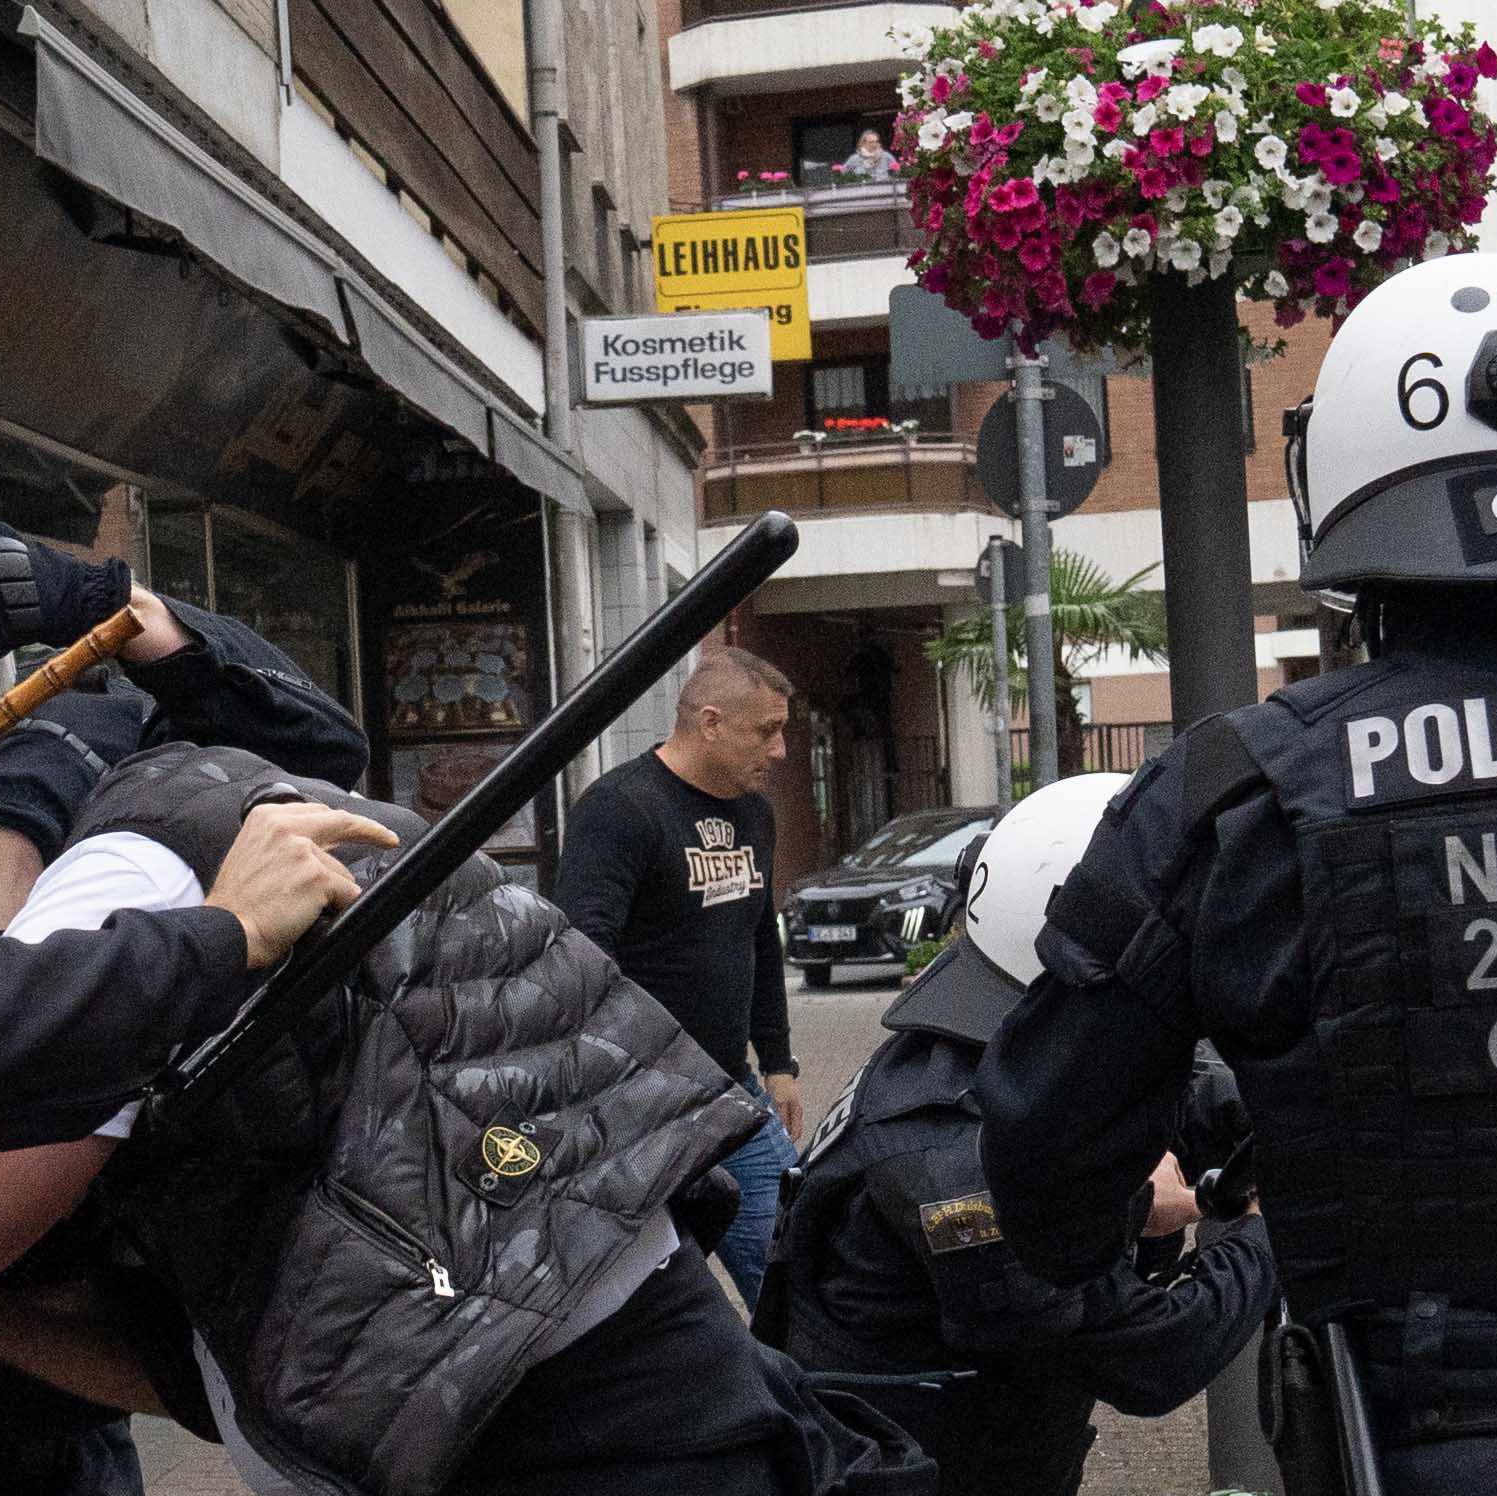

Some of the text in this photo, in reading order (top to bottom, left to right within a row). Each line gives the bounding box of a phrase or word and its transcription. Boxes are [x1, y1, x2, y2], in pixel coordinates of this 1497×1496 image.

[658, 233, 801, 277] LEIHHAUS
[603, 329, 746, 357] Kosmetik
[593, 357, 755, 387] Fusspflege
[1397, 352, 1450, 432] 6
[696, 818, 734, 849] 1978
[686, 847, 763, 890] DIESEL
